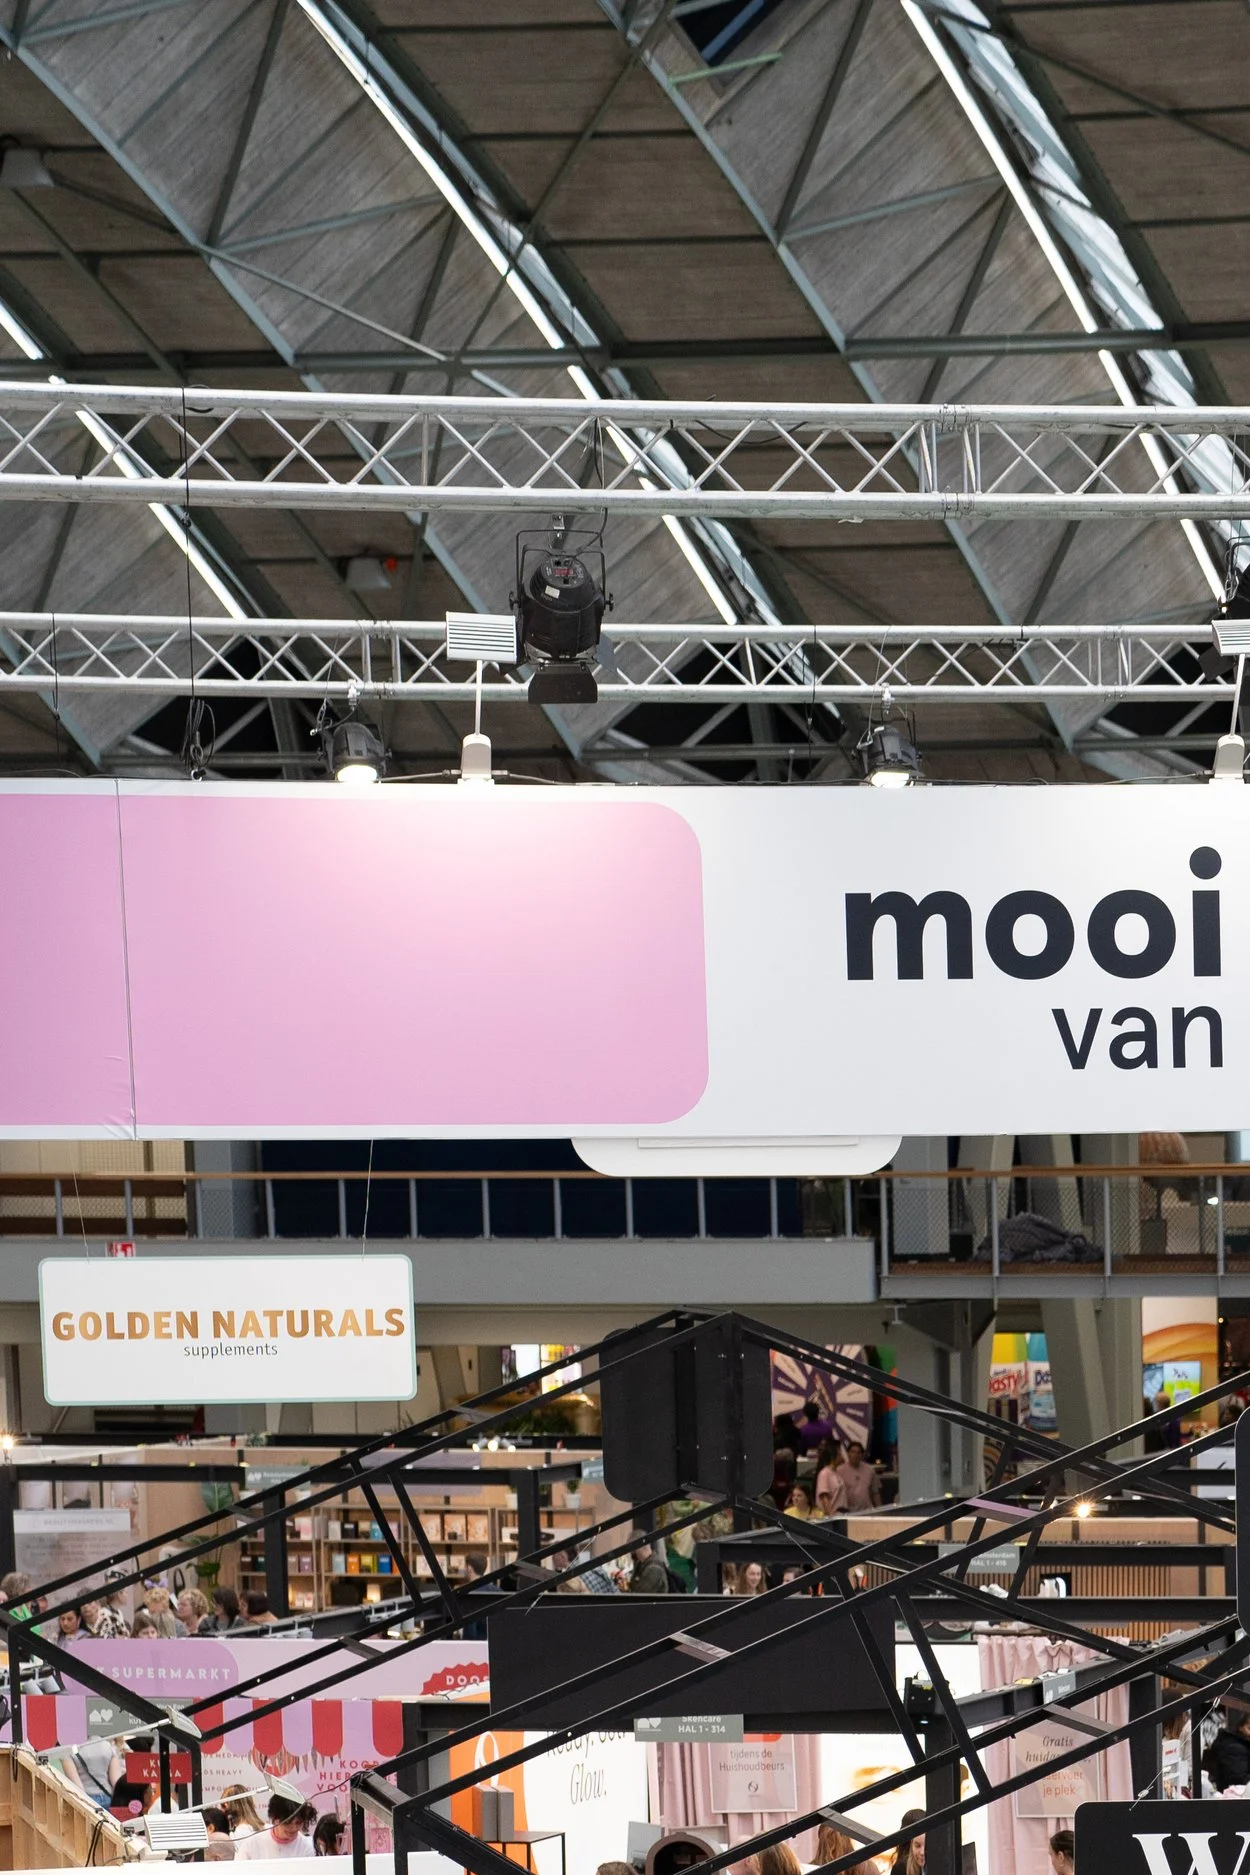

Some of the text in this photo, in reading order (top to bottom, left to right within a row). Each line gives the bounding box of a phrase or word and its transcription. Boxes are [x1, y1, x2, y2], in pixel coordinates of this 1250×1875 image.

[846, 846, 1222, 981] mooi
[1052, 1005, 1224, 1070] van
[52, 1307, 406, 1341] GOLDEN NATURALS
[183, 1341, 279, 1360] supplements
[112, 1665, 231, 1681] SUPERMARKT
[678, 1725, 697, 1734] HAL
[710, 1724, 726, 1734] 314
[1043, 1735, 1074, 1748] Gratis
[730, 1748, 772, 1760] tijdens de
[719, 1761, 785, 1772] Huishoudbeurs
